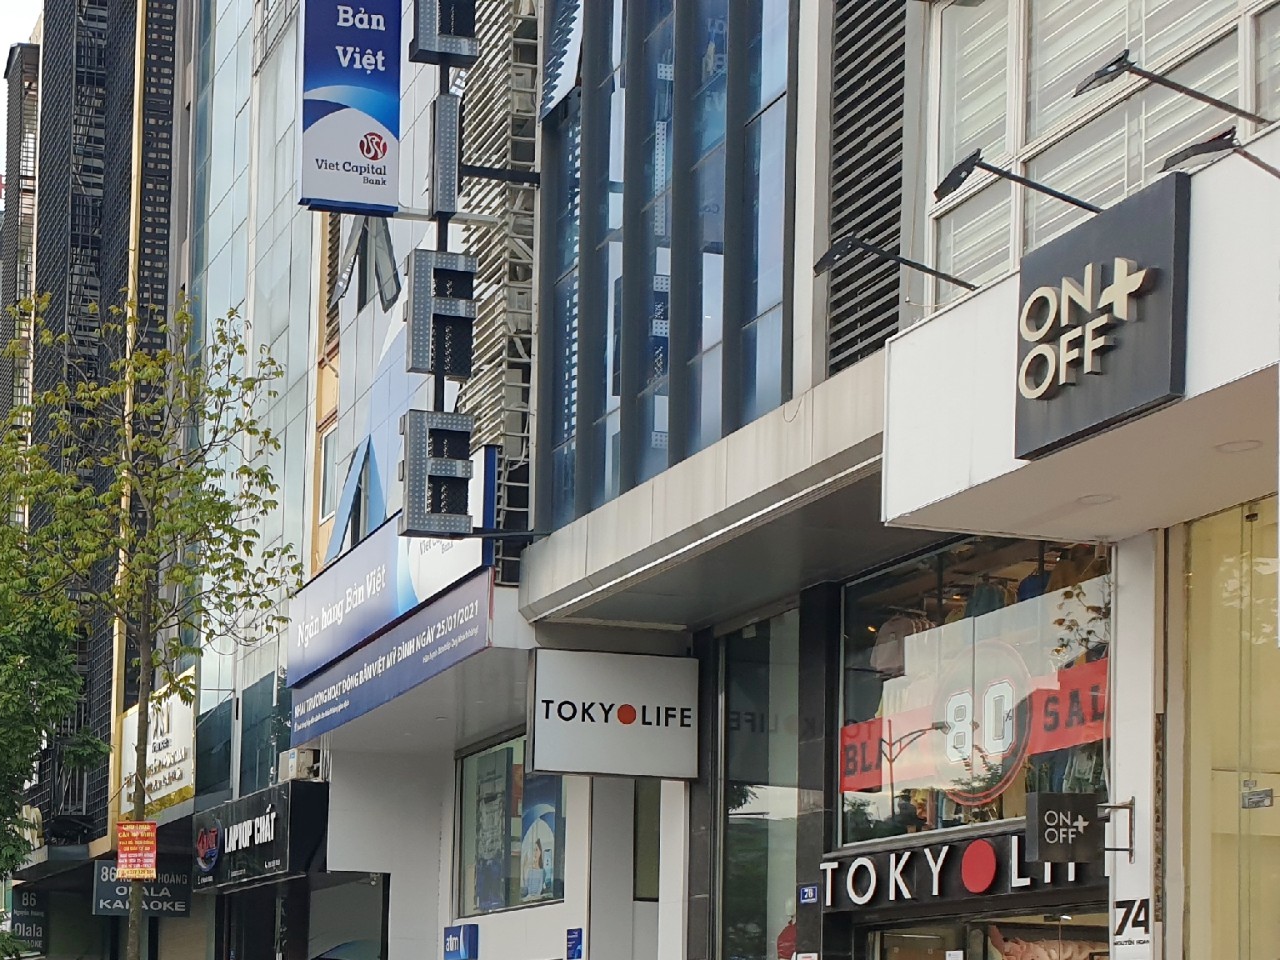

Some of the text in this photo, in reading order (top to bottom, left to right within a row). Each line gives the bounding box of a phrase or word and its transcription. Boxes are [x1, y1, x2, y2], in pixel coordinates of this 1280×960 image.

[337, 5, 386, 31] Bản
[335, 46, 386, 75] Việt
[315, 158, 387, 176] Viet Capital
[362, 177, 387, 186] Bank
[1018, 313, 1114, 399] OFF
[297, 564, 386, 648] Ngân hàng Bản Việt
[416, 624, 436, 652] NGÀY
[436, 600, 479, 639] 25/01/2021
[1044, 810, 1072, 828] ON
[225, 820, 252, 853] LAPTOP
[255, 804, 277, 845] CHẤT
[1044, 828, 1077, 845] OFF
[101, 866, 117, 882] 86
[22, 893, 37, 907] 86
[1114, 899, 1150, 936] 74
[14, 922, 43, 938] Olala
[446, 934, 459, 952] atm
